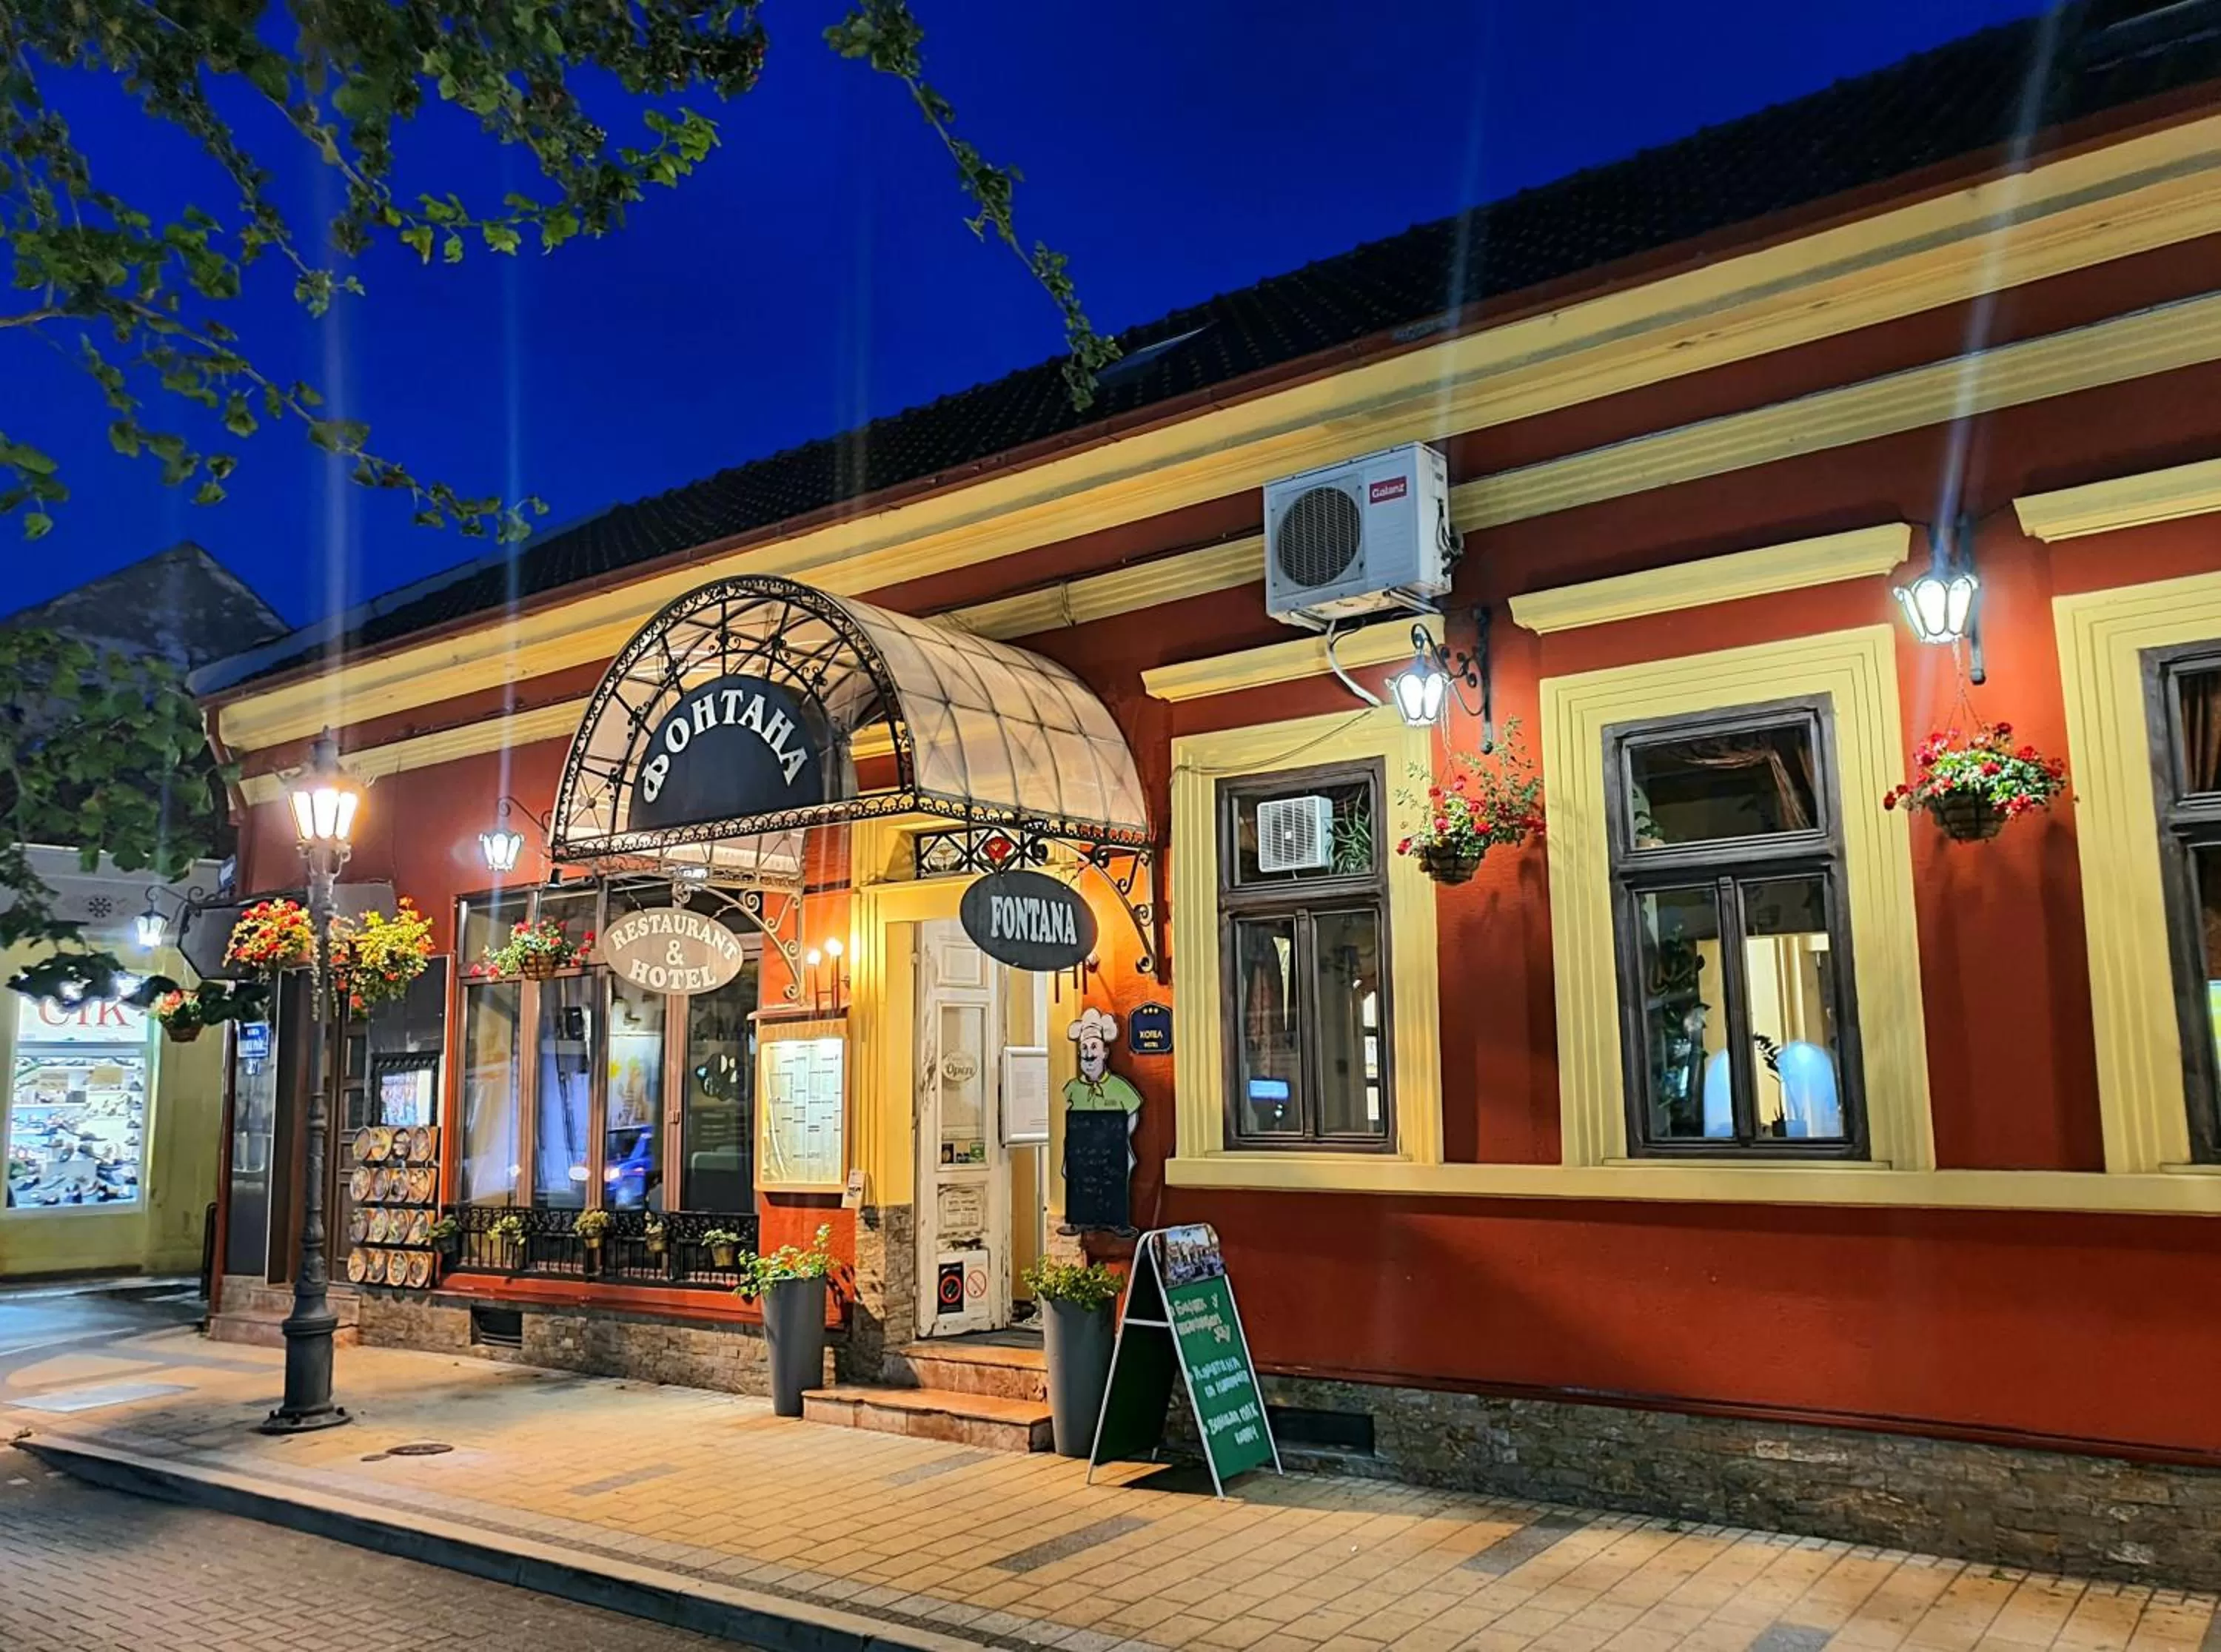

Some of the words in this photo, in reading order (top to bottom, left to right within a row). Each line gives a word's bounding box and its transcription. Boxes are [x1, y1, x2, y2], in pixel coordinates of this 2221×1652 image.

[1372, 483, 1404, 497] Galanz
[642, 689, 808, 803] ФОНТАНА
[990, 896, 1077, 944] FONTANA
[611, 914, 737, 960] RESTAURANT
[666, 940, 683, 965] &
[629, 959, 717, 990] HOTEL
[945, 1063, 974, 1078] Open
